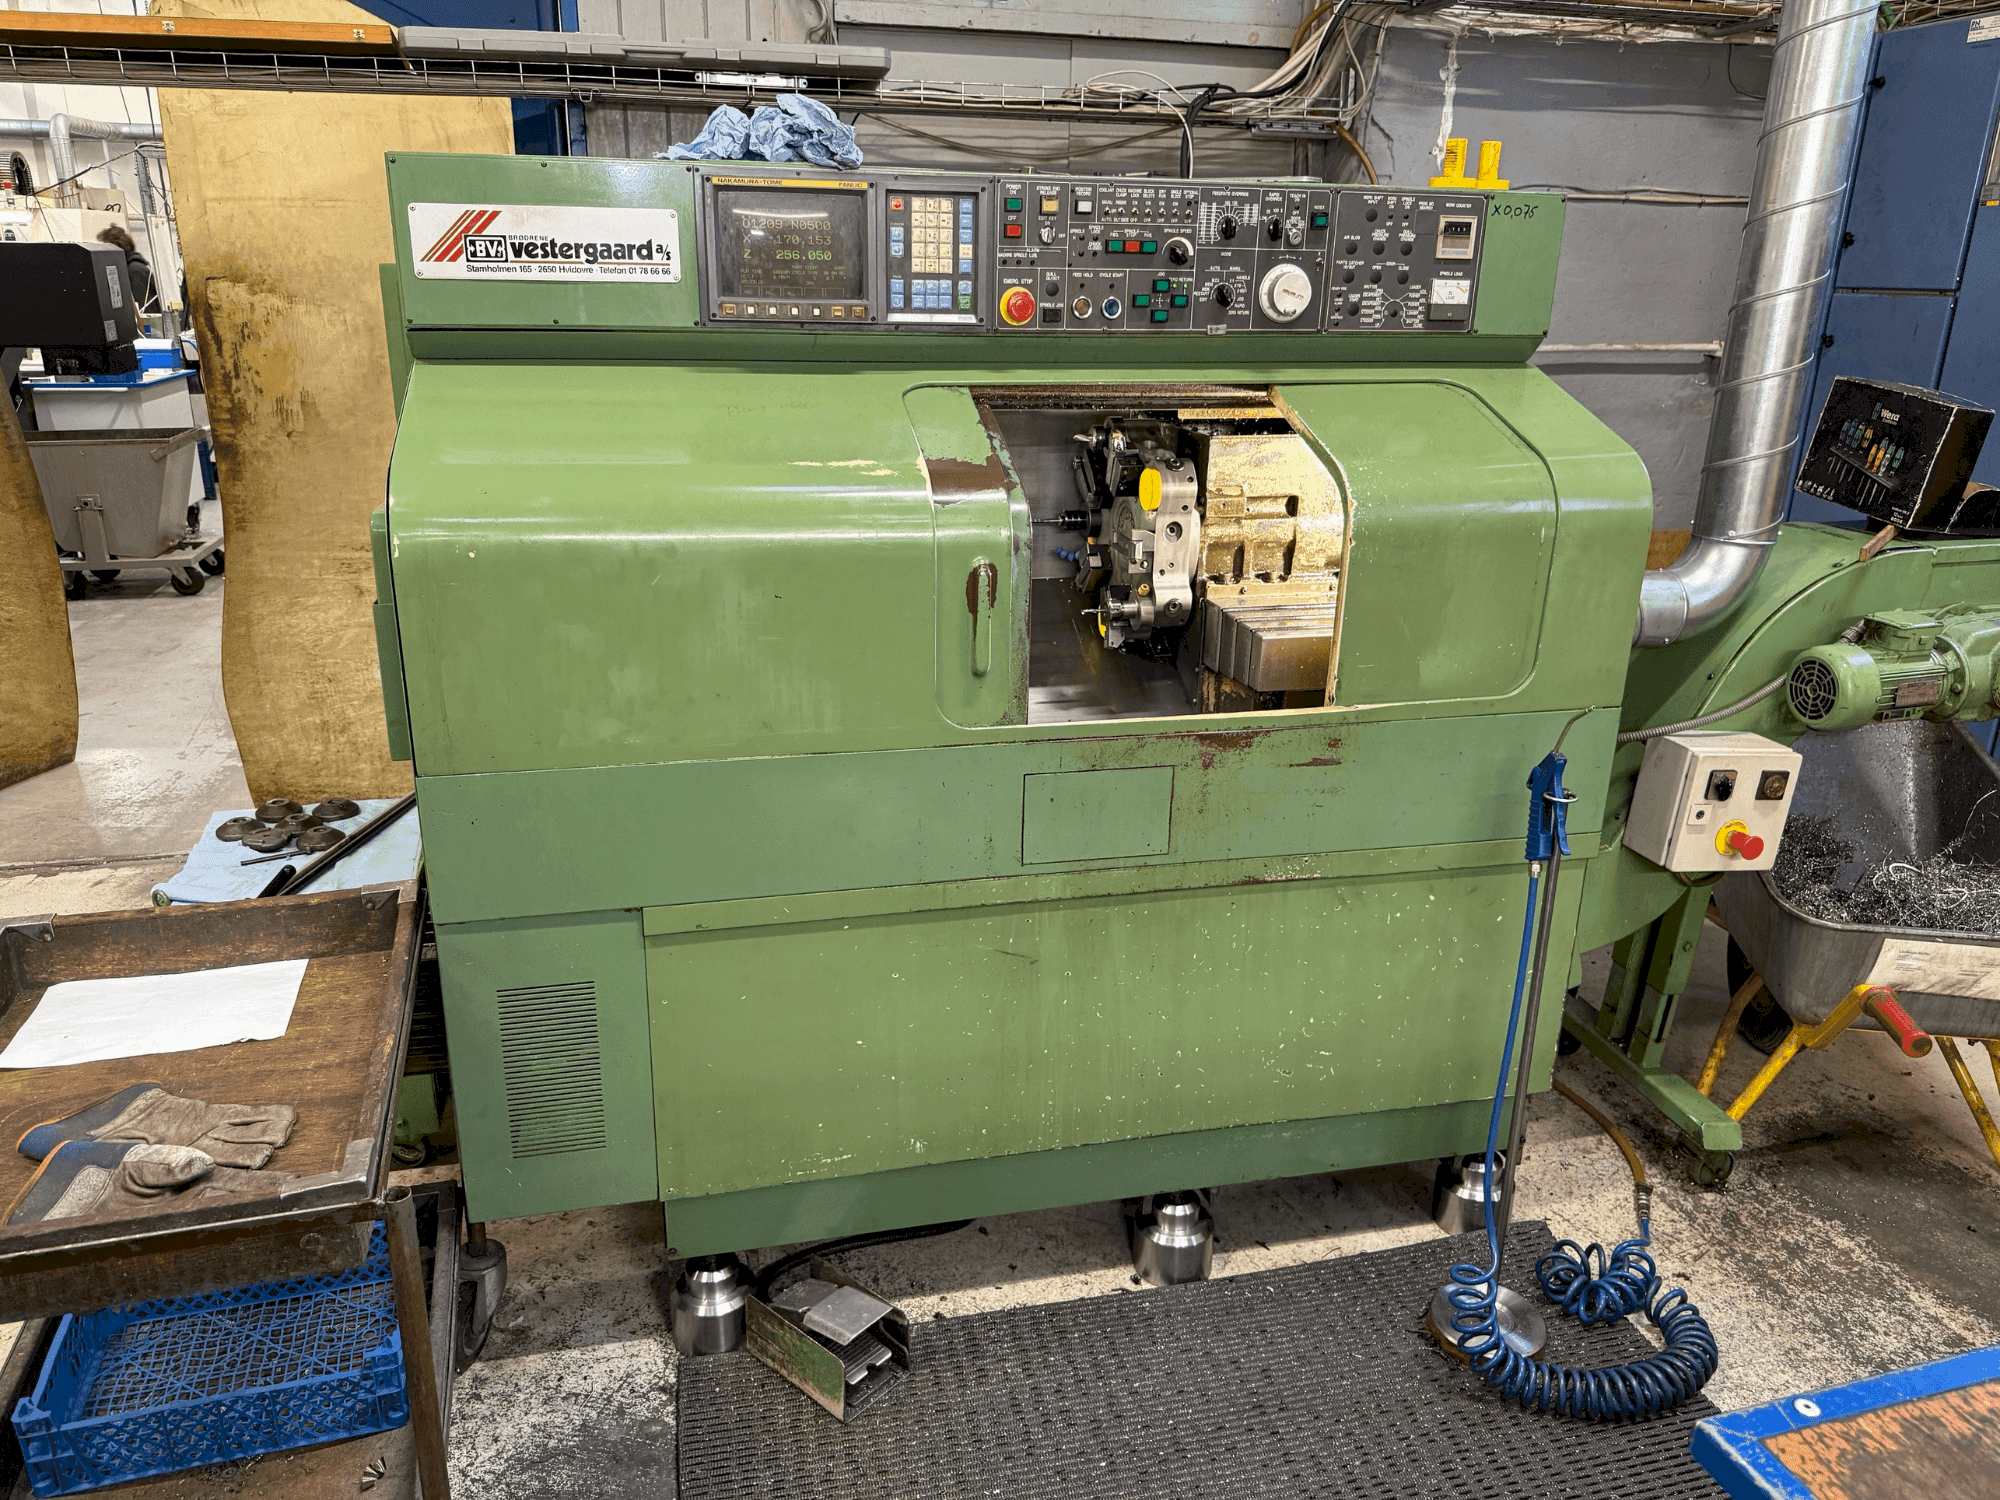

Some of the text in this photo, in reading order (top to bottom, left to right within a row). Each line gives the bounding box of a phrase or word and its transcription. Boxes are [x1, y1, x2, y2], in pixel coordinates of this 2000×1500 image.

[791, 219, 831, 230] N0500
[743, 233, 831, 245] X 170.153
[510, 238, 671, 264] vestergaard a/s
[743, 248, 832, 260] Z 256.050
[466, 264, 517, 273] Stamholmen
[519, 265, 532, 273] 165
[538, 265, 557, 273] 2650
[559, 265, 594, 274] Hvidovre
[599, 266, 626, 274] Telefon
[639, 267, 649, 275] 78
[650, 267, 660, 275] 66
[662, 267, 671, 275] 66
[1880, 408, 1901, 422] Wera
